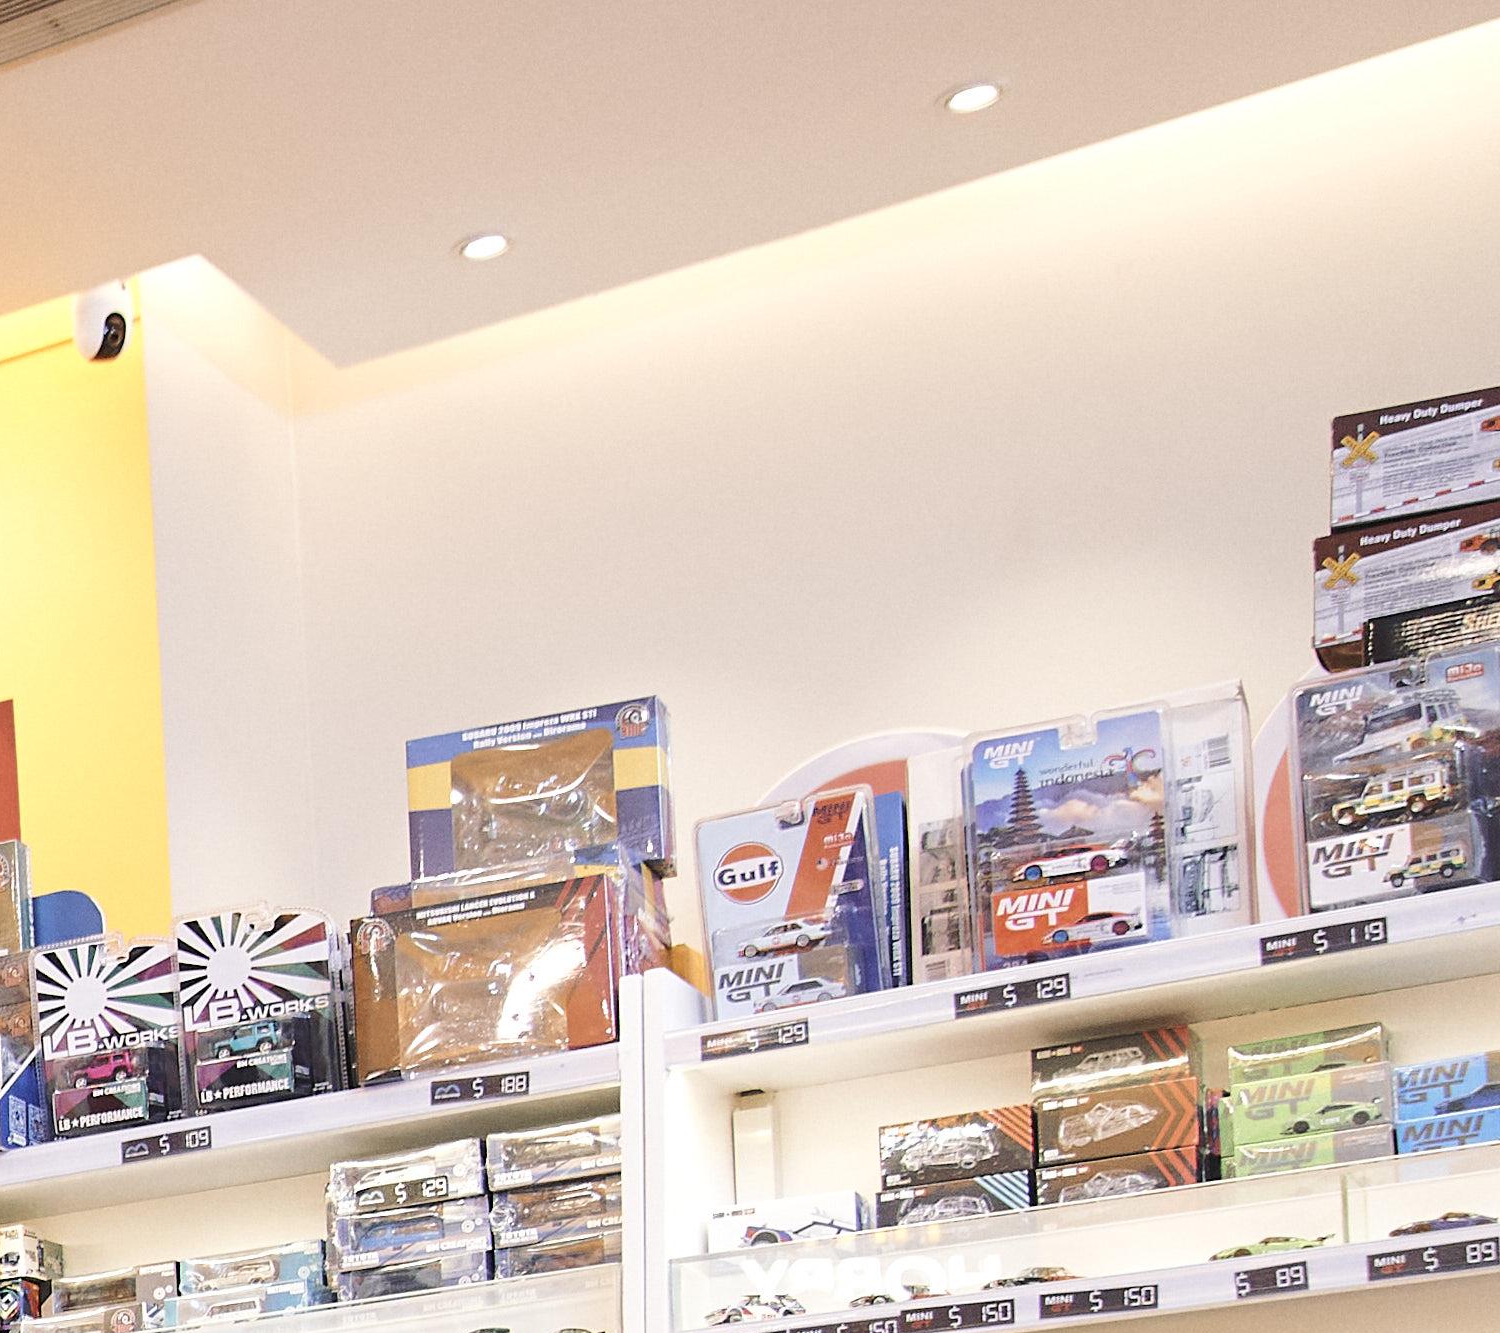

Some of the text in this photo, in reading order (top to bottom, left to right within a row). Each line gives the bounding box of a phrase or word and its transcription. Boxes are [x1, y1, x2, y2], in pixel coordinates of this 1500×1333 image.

[1379, 398, 1483, 426] Heavy Duty Dumper
[1360, 519, 1462, 546] Heavy Duty Dumper
[717, 860, 779, 887] Gulf
[997, 888, 1074, 916] MINI
[1004, 907, 1072, 931] GT
[718, 962, 784, 990] MINI
[472, 1074, 527, 1099] $ 188
[160, 1130, 209, 1155] $ 109
[395, 1178, 447, 1204] $ 129
[1237, 1265, 1304, 1297] $ 89
